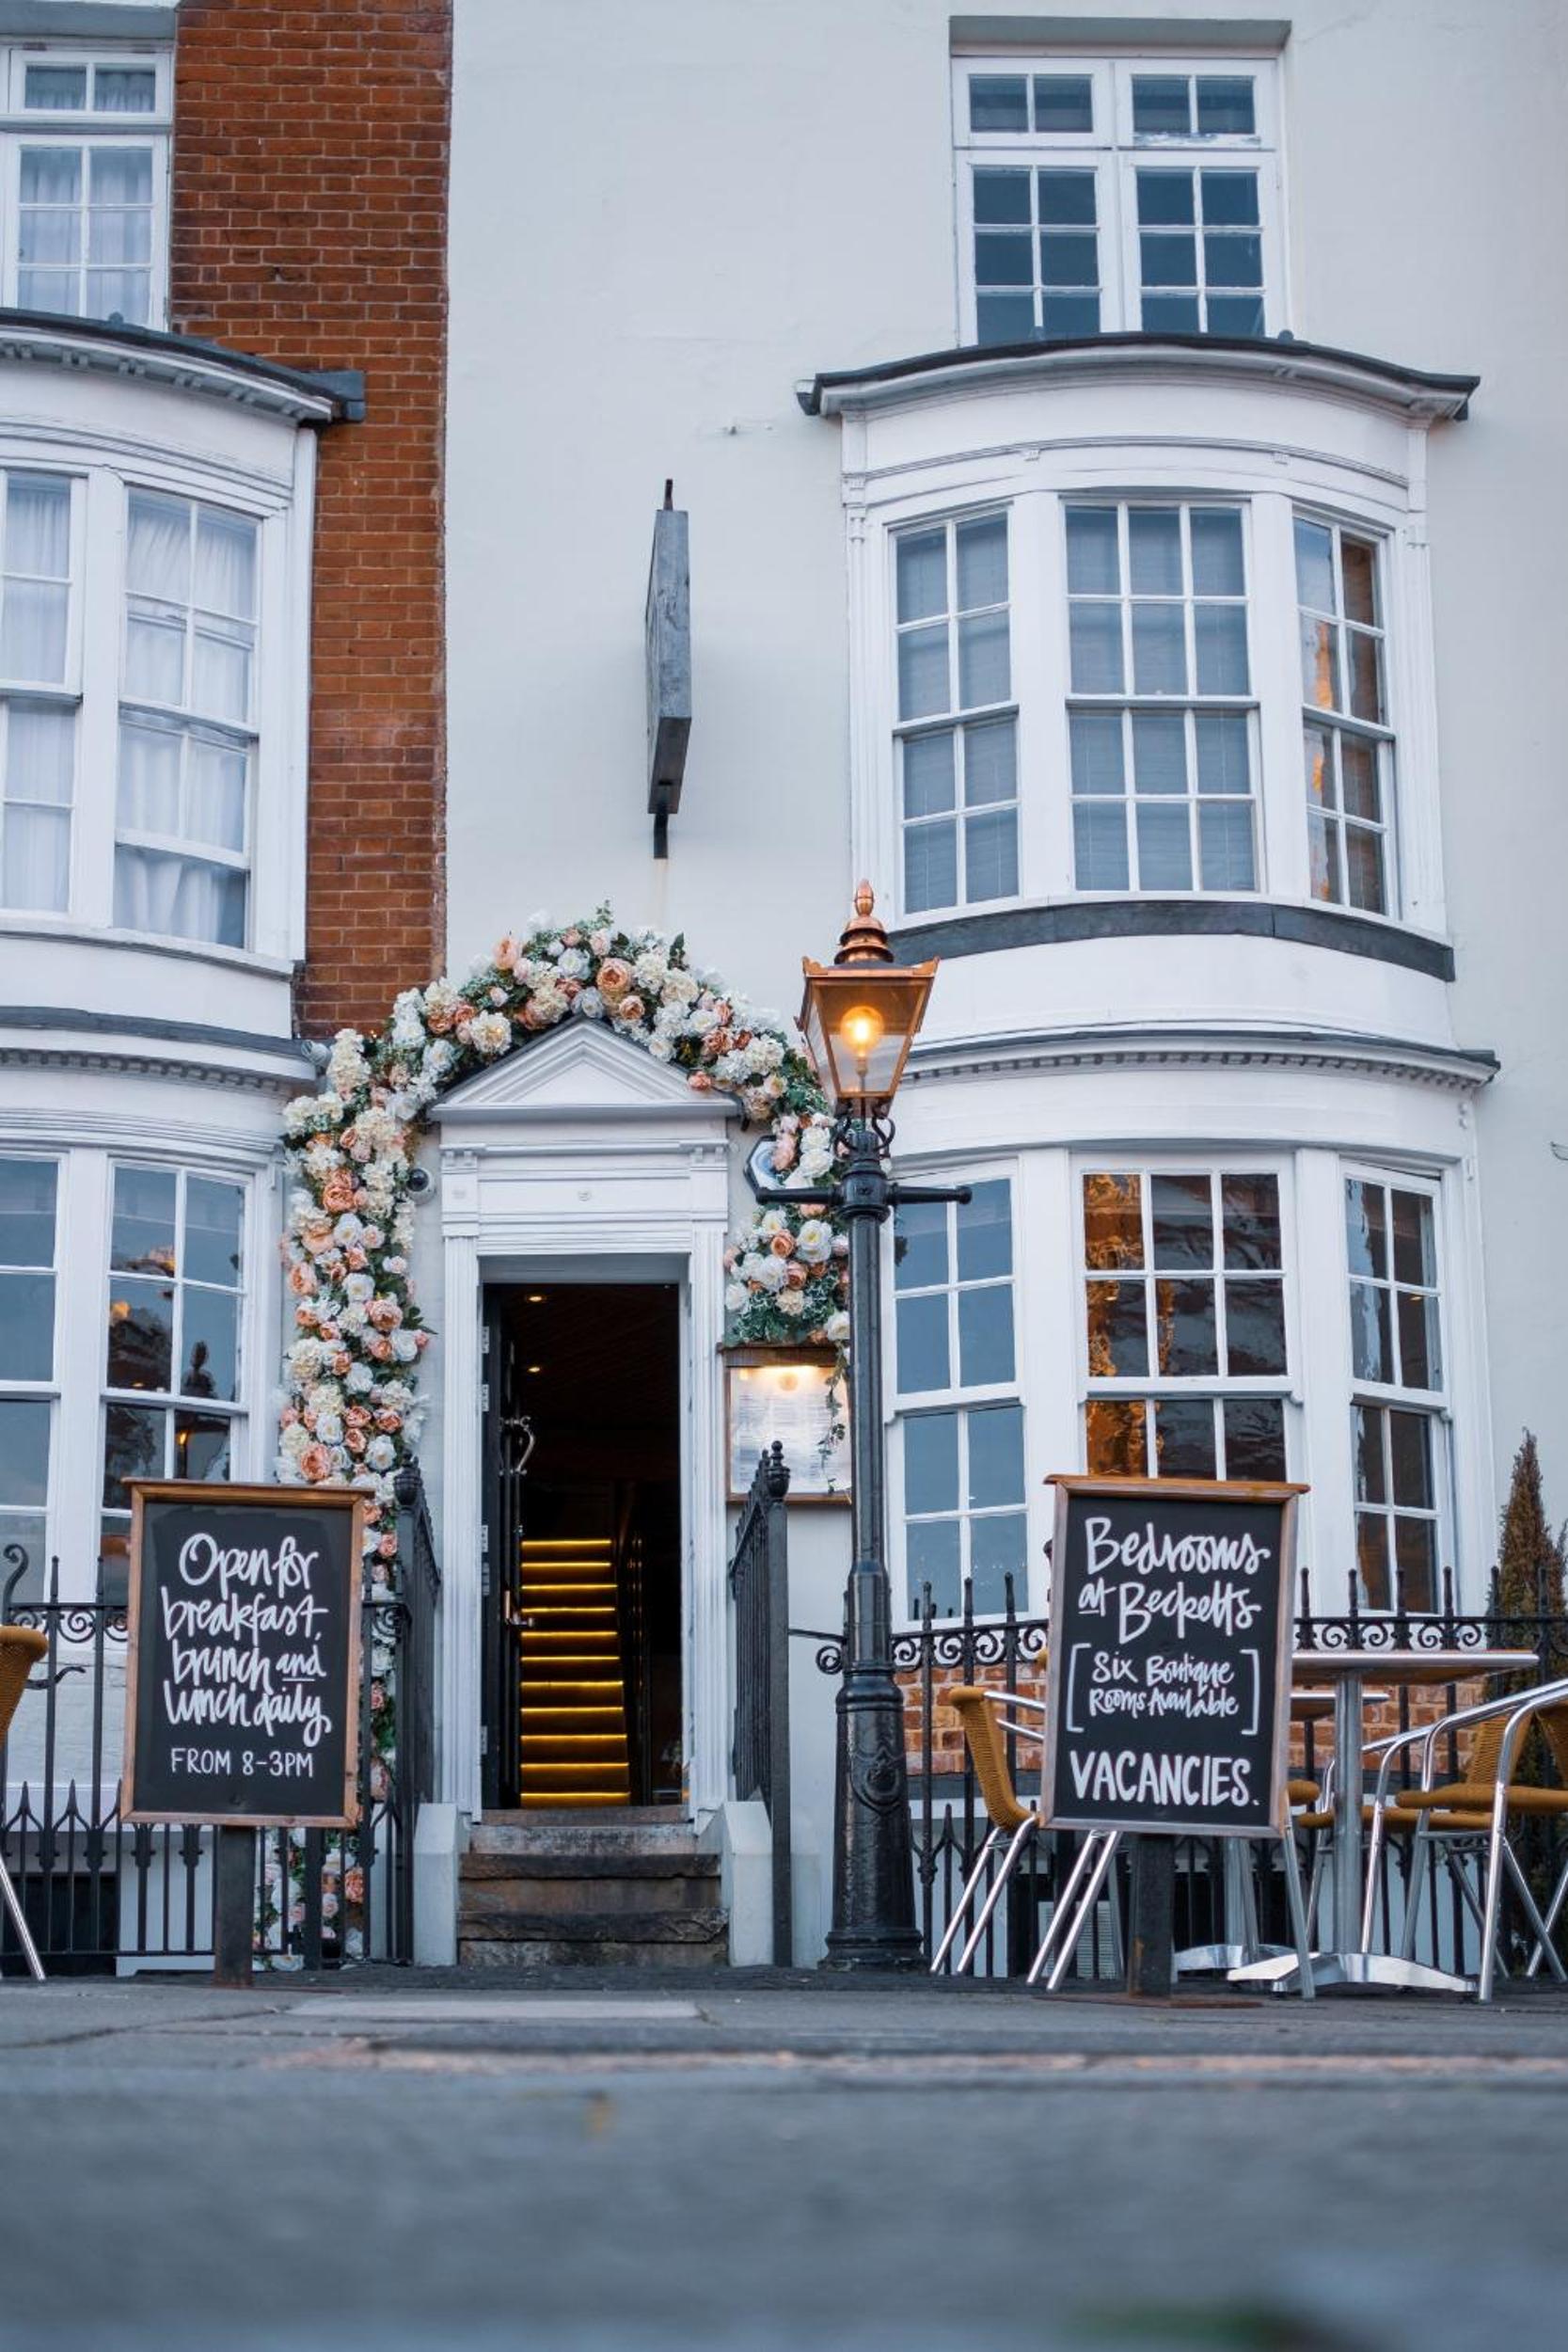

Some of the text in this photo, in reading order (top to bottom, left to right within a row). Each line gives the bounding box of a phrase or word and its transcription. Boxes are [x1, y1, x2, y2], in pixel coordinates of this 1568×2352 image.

[180, 1533, 319, 1598] Open for
[1085, 1517, 1270, 1575] Bedrooms
[161, 1585, 328, 1645] breakfast,
[1078, 1577, 1262, 1645] at Becketts
[172, 1639, 326, 1694] brunch and
[1092, 1651, 1235, 1697] Six Boutique
[163, 1680, 332, 1748] lunch daily
[1088, 1688, 1239, 1719] Rooms Available
[170, 1748, 313, 1778] FROM 8-3PM
